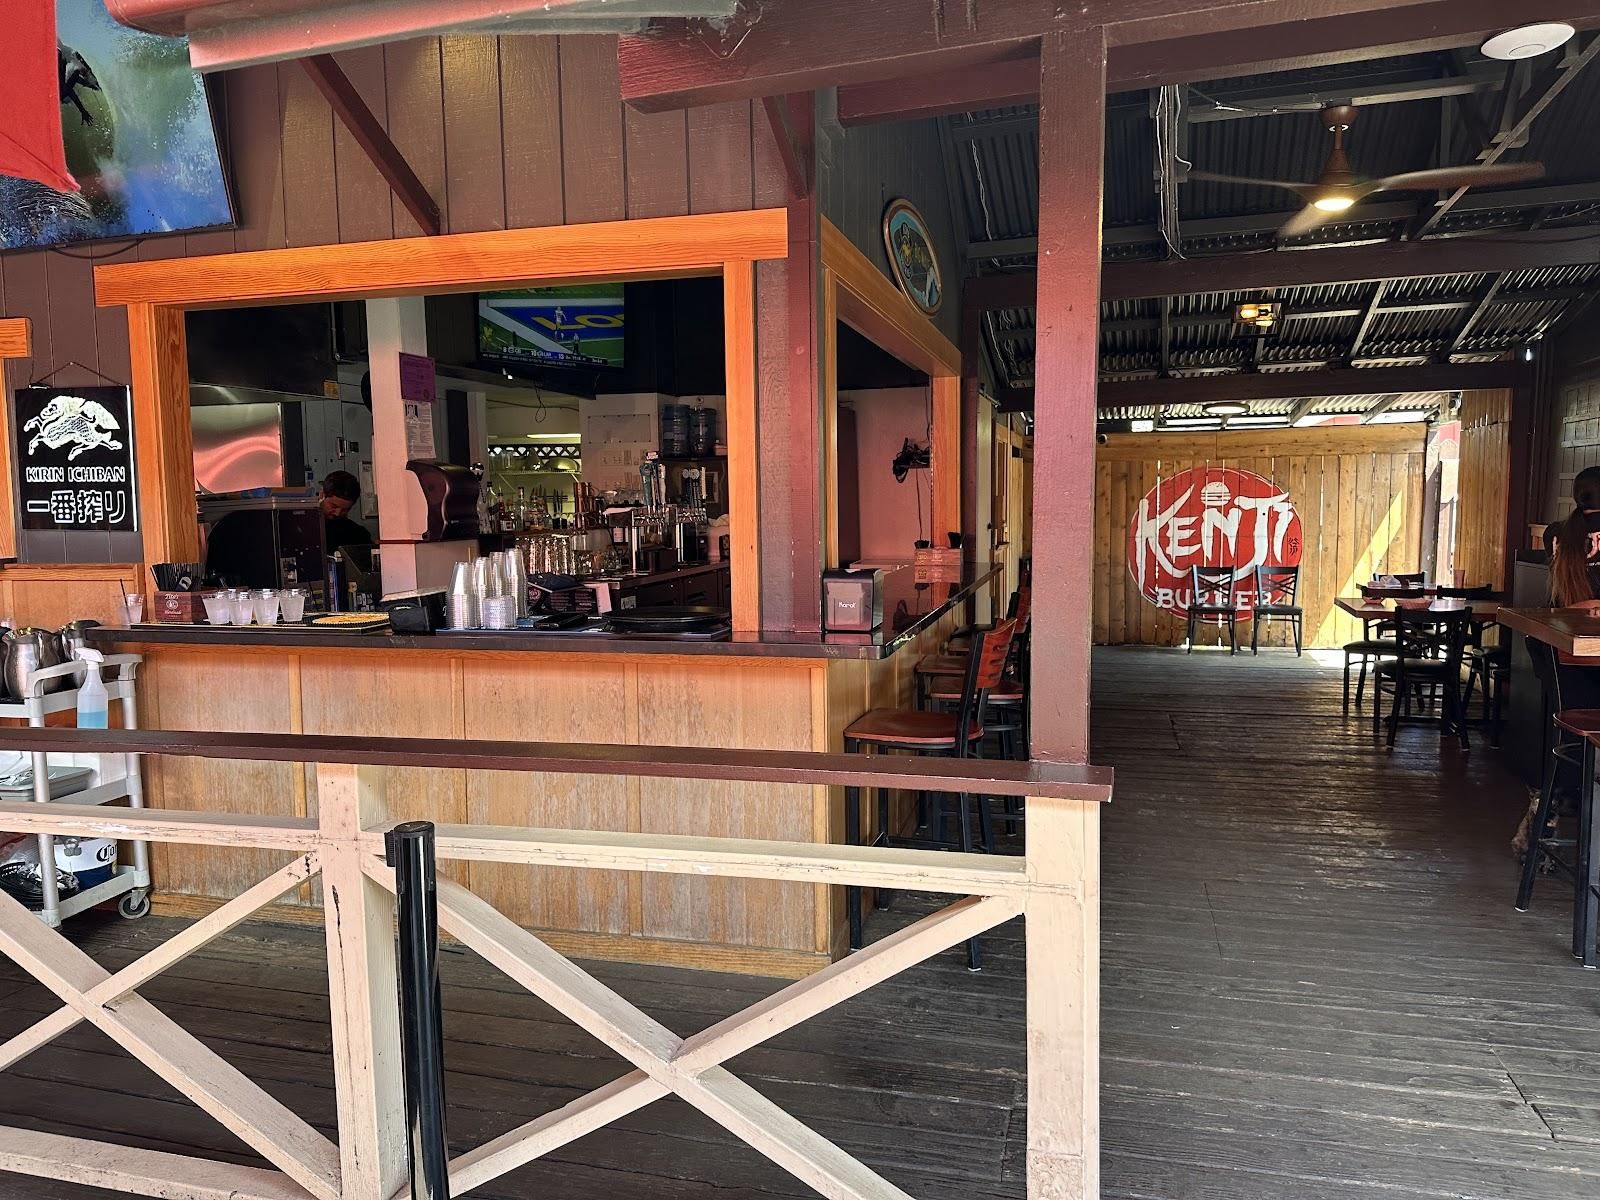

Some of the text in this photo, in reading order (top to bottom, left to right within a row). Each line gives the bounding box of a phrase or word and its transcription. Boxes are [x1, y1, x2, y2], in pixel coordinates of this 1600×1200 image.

[26, 466, 125, 482] KIRIN ICHIBAN
[27, 490, 126, 524] 一番搾り
[1135, 483, 1294, 596] KENJI
